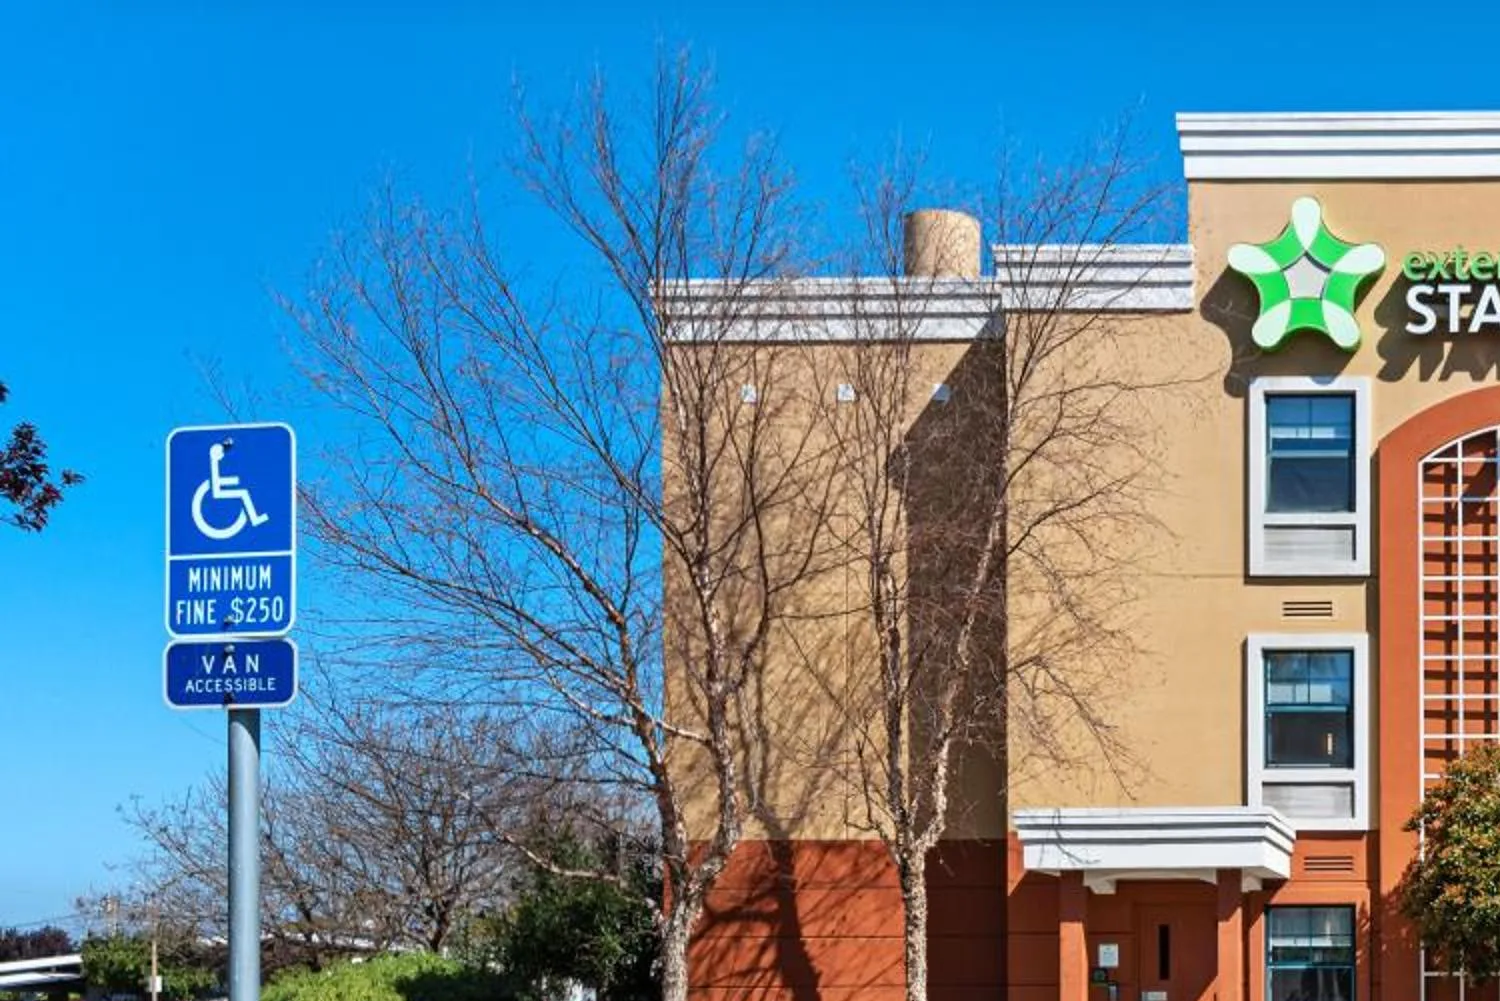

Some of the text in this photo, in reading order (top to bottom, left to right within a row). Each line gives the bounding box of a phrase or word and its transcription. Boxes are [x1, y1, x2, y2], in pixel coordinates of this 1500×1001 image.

[188, 564, 272, 593] MINIMUM
[176, 596, 284, 625] FINE $250
[201, 653, 260, 674] VAN
[185, 677, 277, 693] ACCESSIBLE
